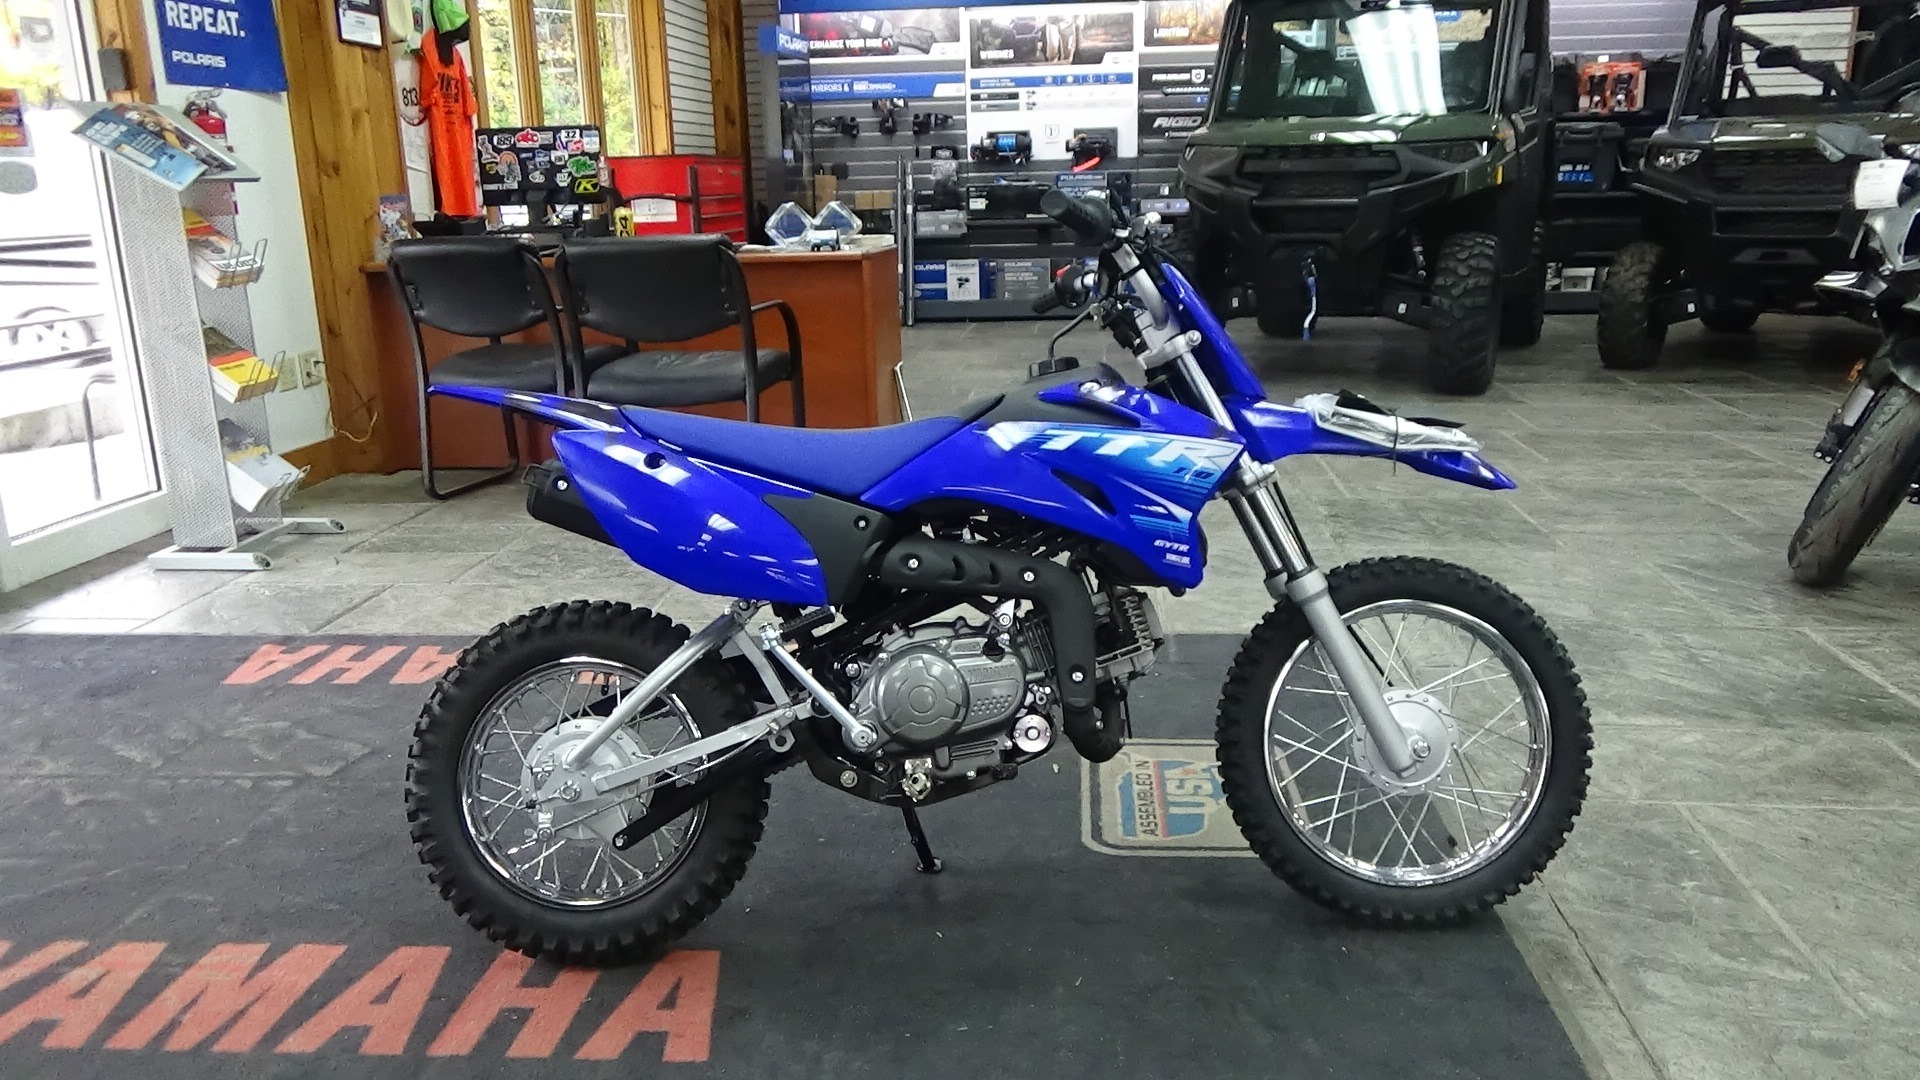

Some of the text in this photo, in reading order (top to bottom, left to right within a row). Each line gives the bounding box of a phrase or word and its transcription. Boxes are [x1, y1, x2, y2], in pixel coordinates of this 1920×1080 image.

[165, 0, 246, 38] REPEAT.
[171, 50, 227, 68] POLARIS
[402, 87, 419, 107] 813
[1152, 115, 1203, 129] RIGID
[1040, 429, 1239, 473] TTR
[1153, 539, 1190, 553] GYTR
[1135, 760, 1159, 837] ASSEMBLED IN
[1164, 761, 1221, 815] USA
